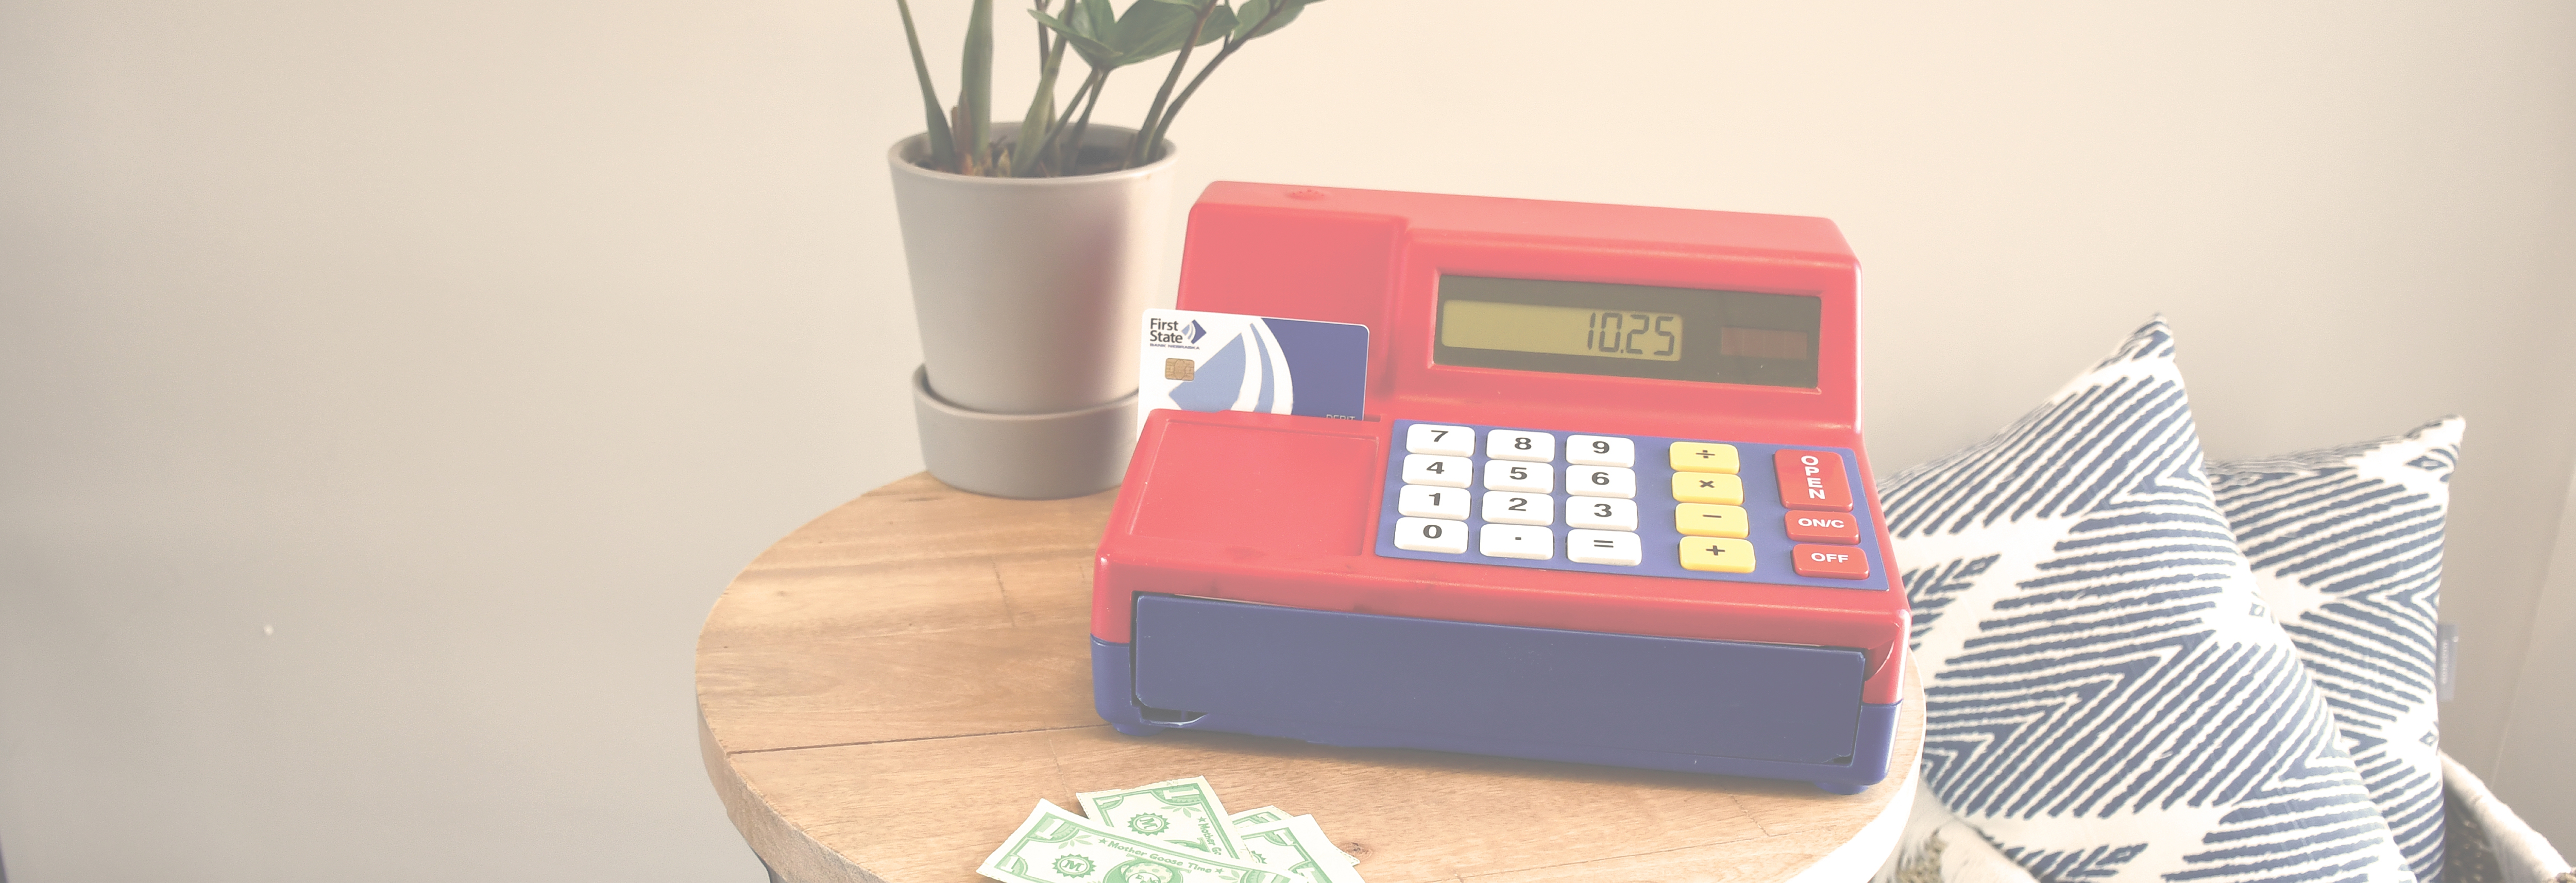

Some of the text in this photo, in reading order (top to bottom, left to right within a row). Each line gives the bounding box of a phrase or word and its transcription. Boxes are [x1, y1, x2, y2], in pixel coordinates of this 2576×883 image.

[1150, 318, 1179, 331] First
[1150, 330, 1183, 344] State
[1587, 312, 1675, 356] 10.25
[1431, 430, 1449, 442] 7
[1514, 437, 1532, 450] 8
[1592, 441, 1609, 454] 9
[1426, 462, 1445, 474] 4
[1510, 467, 1528, 480] 5
[1591, 472, 1609, 485] 6
[1801, 455, 1826, 499] OPEN
[1428, 493, 1440, 506] 1
[1508, 497, 1528, 511] 2
[1594, 504, 1612, 518] 3
[1798, 518, 1845, 528] ON/C
[1423, 525, 1442, 539] 0
[1811, 553, 1849, 563] OFF
[1139, 818, 1158, 828] M
[1197, 823, 1216, 846] Mother
[1107, 841, 1212, 873] Mother Goose Time
[1062, 860, 1084, 871] M
